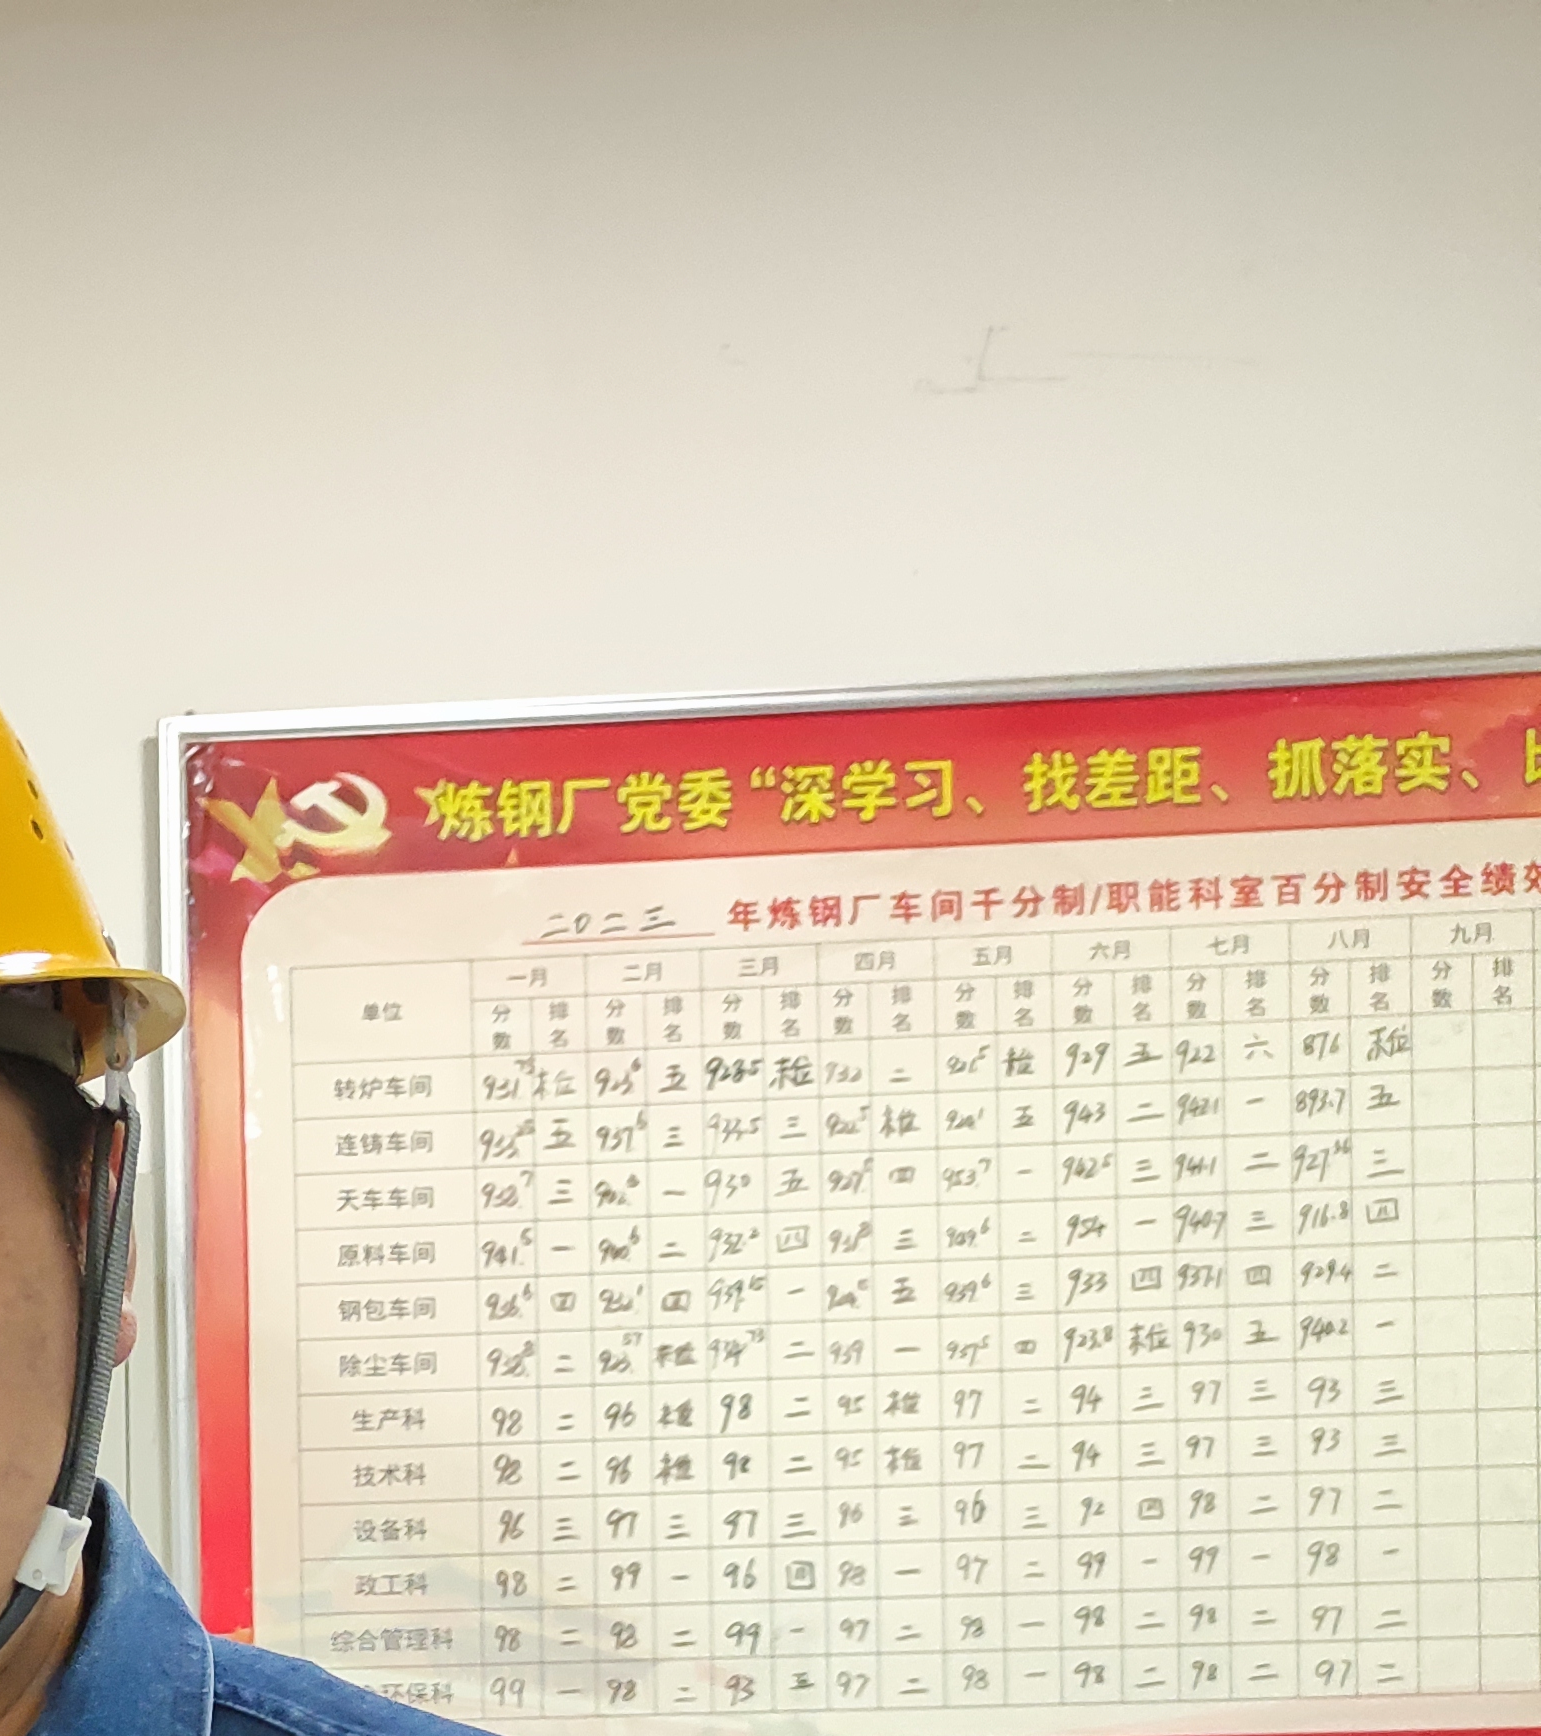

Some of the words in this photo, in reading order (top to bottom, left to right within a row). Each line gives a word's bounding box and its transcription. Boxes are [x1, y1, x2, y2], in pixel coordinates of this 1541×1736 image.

[435, 728, 1541, 843] 炼钢厂党委“深学习、找差距、抓落实、
[506, 967, 548, 988] 一月
[622, 961, 663, 982] 二月
[738, 955, 780, 978] 三月
[854, 950, 896, 972] 四月
[972, 945, 1013, 967] 五月
[1089, 939, 1131, 961] 六月
[1206, 934, 1250, 957] 七月
[1327, 927, 1371, 950] 八月
[1449, 921, 1493, 945] 九月
[362, 1002, 402, 1022] 单位
[333, 1074, 432, 1100] 转炉车间
[336, 1186, 434, 1212] 天车车间
[337, 1241, 436, 1268] 原料车间
[338, 1296, 436, 1322] 钢包车间
[339, 1351, 437, 1378] 除尘车间
[352, 1407, 426, 1432] 生产科
[353, 1462, 427, 1488] 技术科
[353, 1518, 428, 1543] 设备科
[354, 1572, 429, 1597] 政工科
[330, 1627, 454, 1653] 综合管理科
